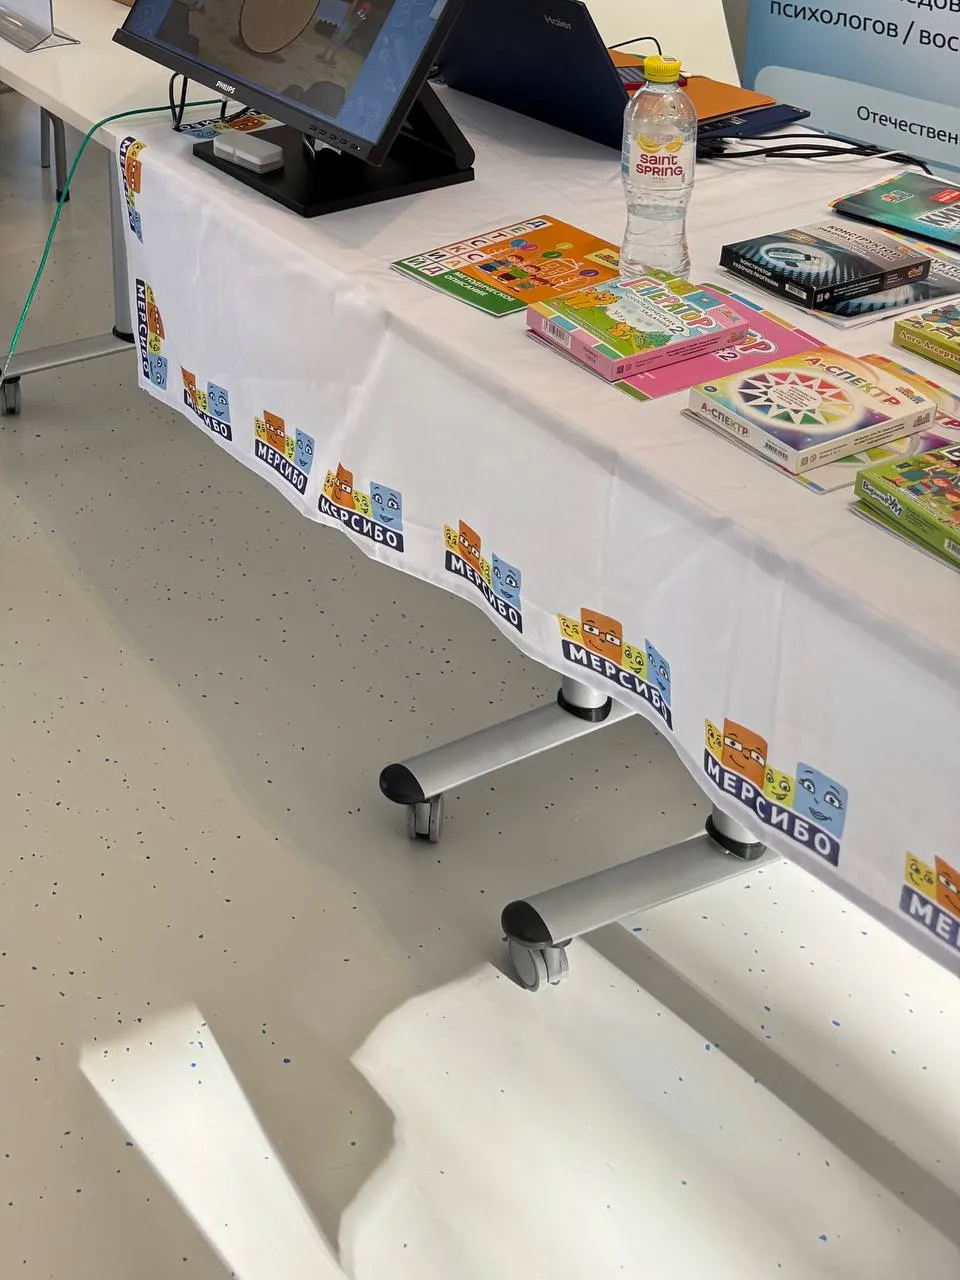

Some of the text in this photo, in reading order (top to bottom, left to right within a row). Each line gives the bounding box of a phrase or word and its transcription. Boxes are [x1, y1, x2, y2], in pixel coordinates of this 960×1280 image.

[770, 0, 899, 38] психологов
[215, 80, 236, 94] PHILIPS
[857, 105, 959, 145] Отечествен
[636, 164, 684, 177] SPRING
[826, 225, 901, 257] КОНСТРУКТОР
[740, 259, 772, 277] КОНСТРУКТОР
[618, 277, 714, 328] ГЕНЕРАТОР
[669, 325, 685, 335] 2
[719, 352, 738, 361] 2
[803, 356, 901, 407] А-СПЕКТР
[700, 402, 749, 437] А-СПЕКТР
[258, 442, 305, 490] МЕРСИБО
[320, 497, 398, 548] МЕРСИБО
[450, 554, 520, 626] МЕРСИБО
[569, 644, 669, 721] МЕРСИБО
[707, 754, 832, 856] МЕРСИБО
[909, 892, 960, 946] МЕ
